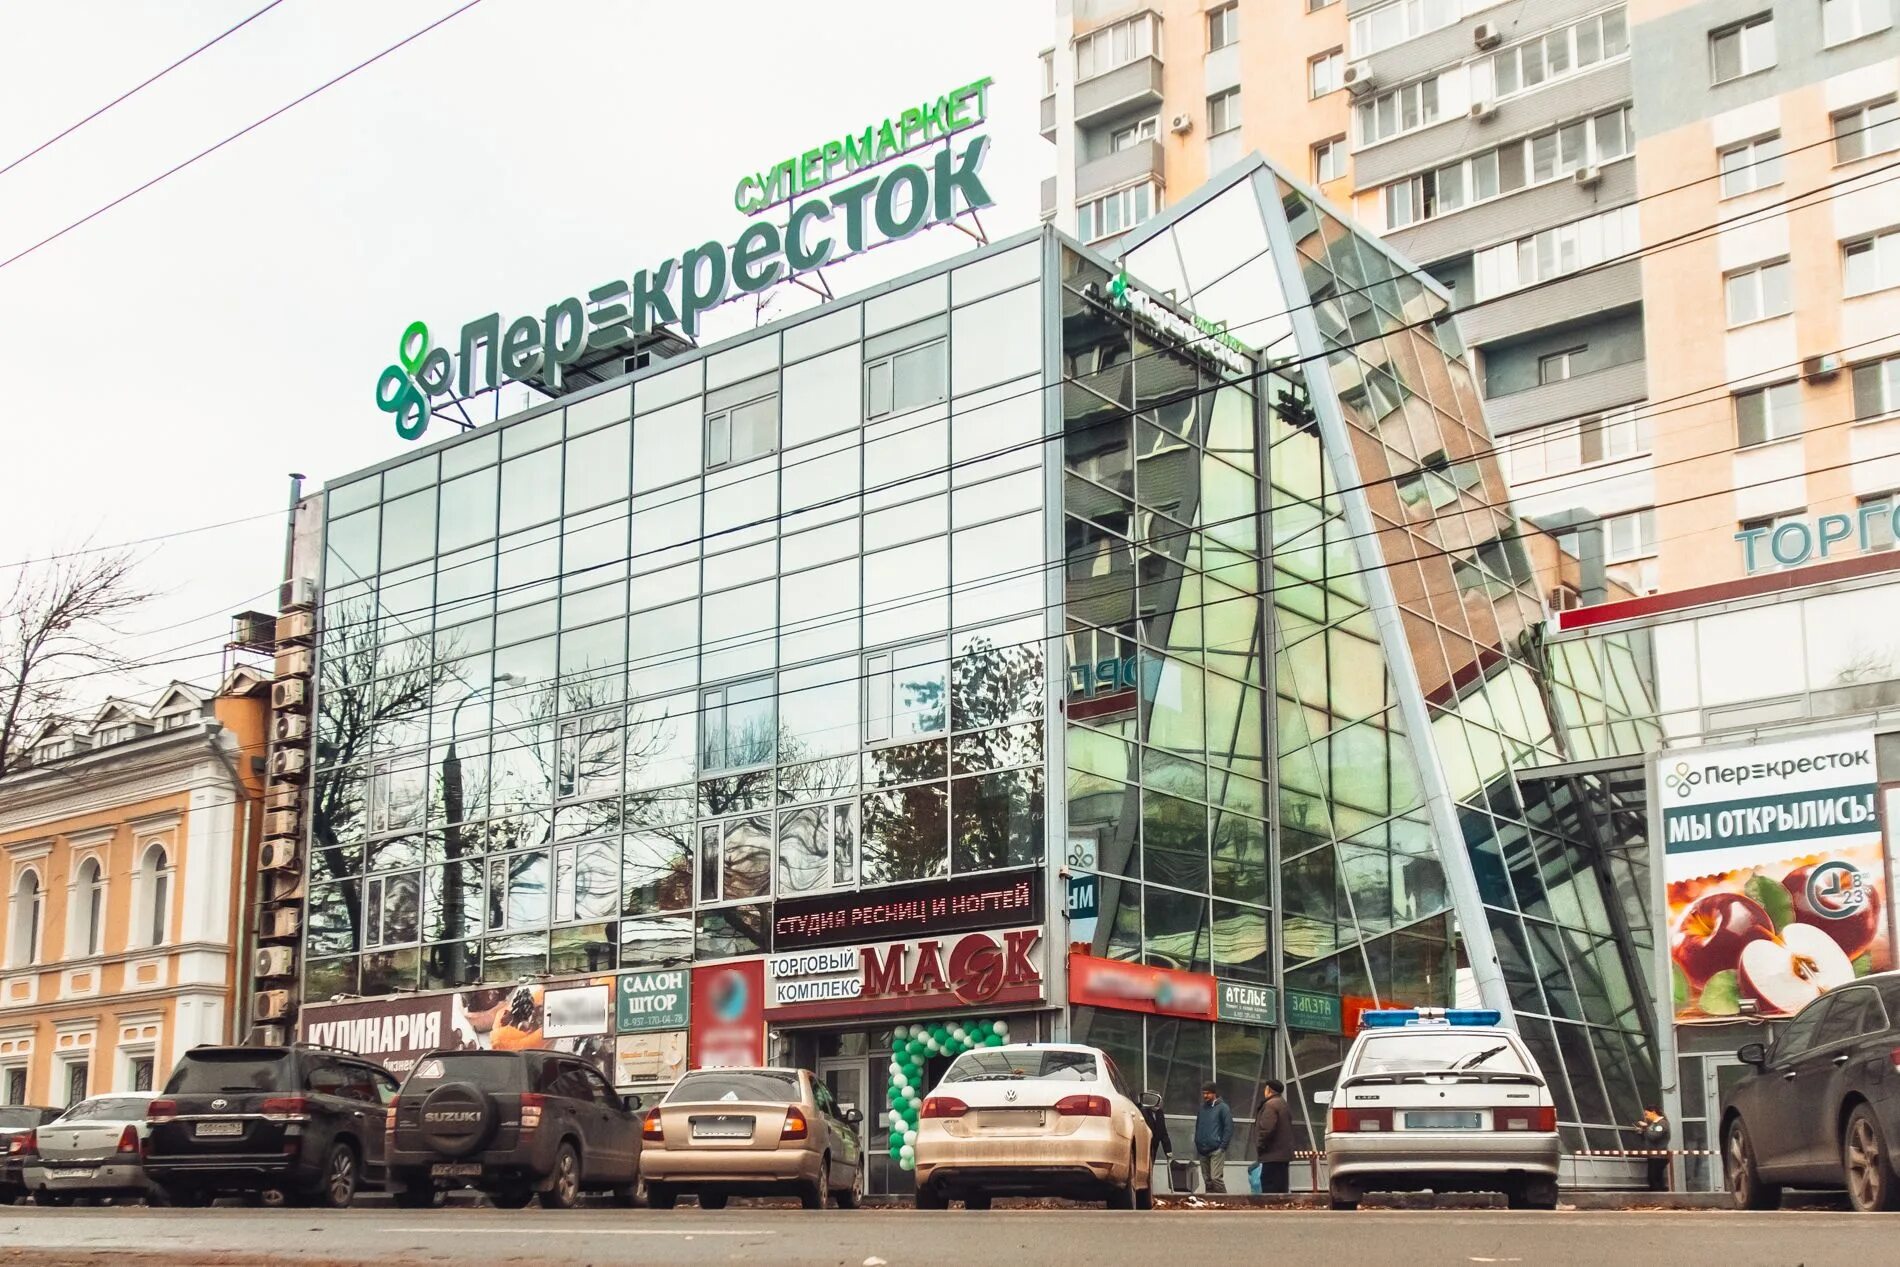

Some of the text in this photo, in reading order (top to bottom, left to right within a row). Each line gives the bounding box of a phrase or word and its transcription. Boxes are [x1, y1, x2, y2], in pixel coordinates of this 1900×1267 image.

[734, 76, 995, 215] СУПЕРМАРКЕТ
[1734, 504, 1900, 575] ТОРГ
[1670, 794, 1876, 843] МЫ ОТКРЫЛИСЬ!
[776, 882, 1030, 937] СТУДИЯ РЕСНИЦ И НОГТЕЙ
[769, 947, 855, 976] ТОРГОВЫЙ
[623, 972, 683, 993] САЛОН
[777, 978, 861, 1001] КОМПЛЕКС
[1226, 987, 1267, 1007] АТЕЛЬЕ
[629, 995, 678, 1014] ШТОР
[308, 1011, 441, 1055] КУЛИНАРИЯ
[425, 1111, 482, 1122] SUZUKI
